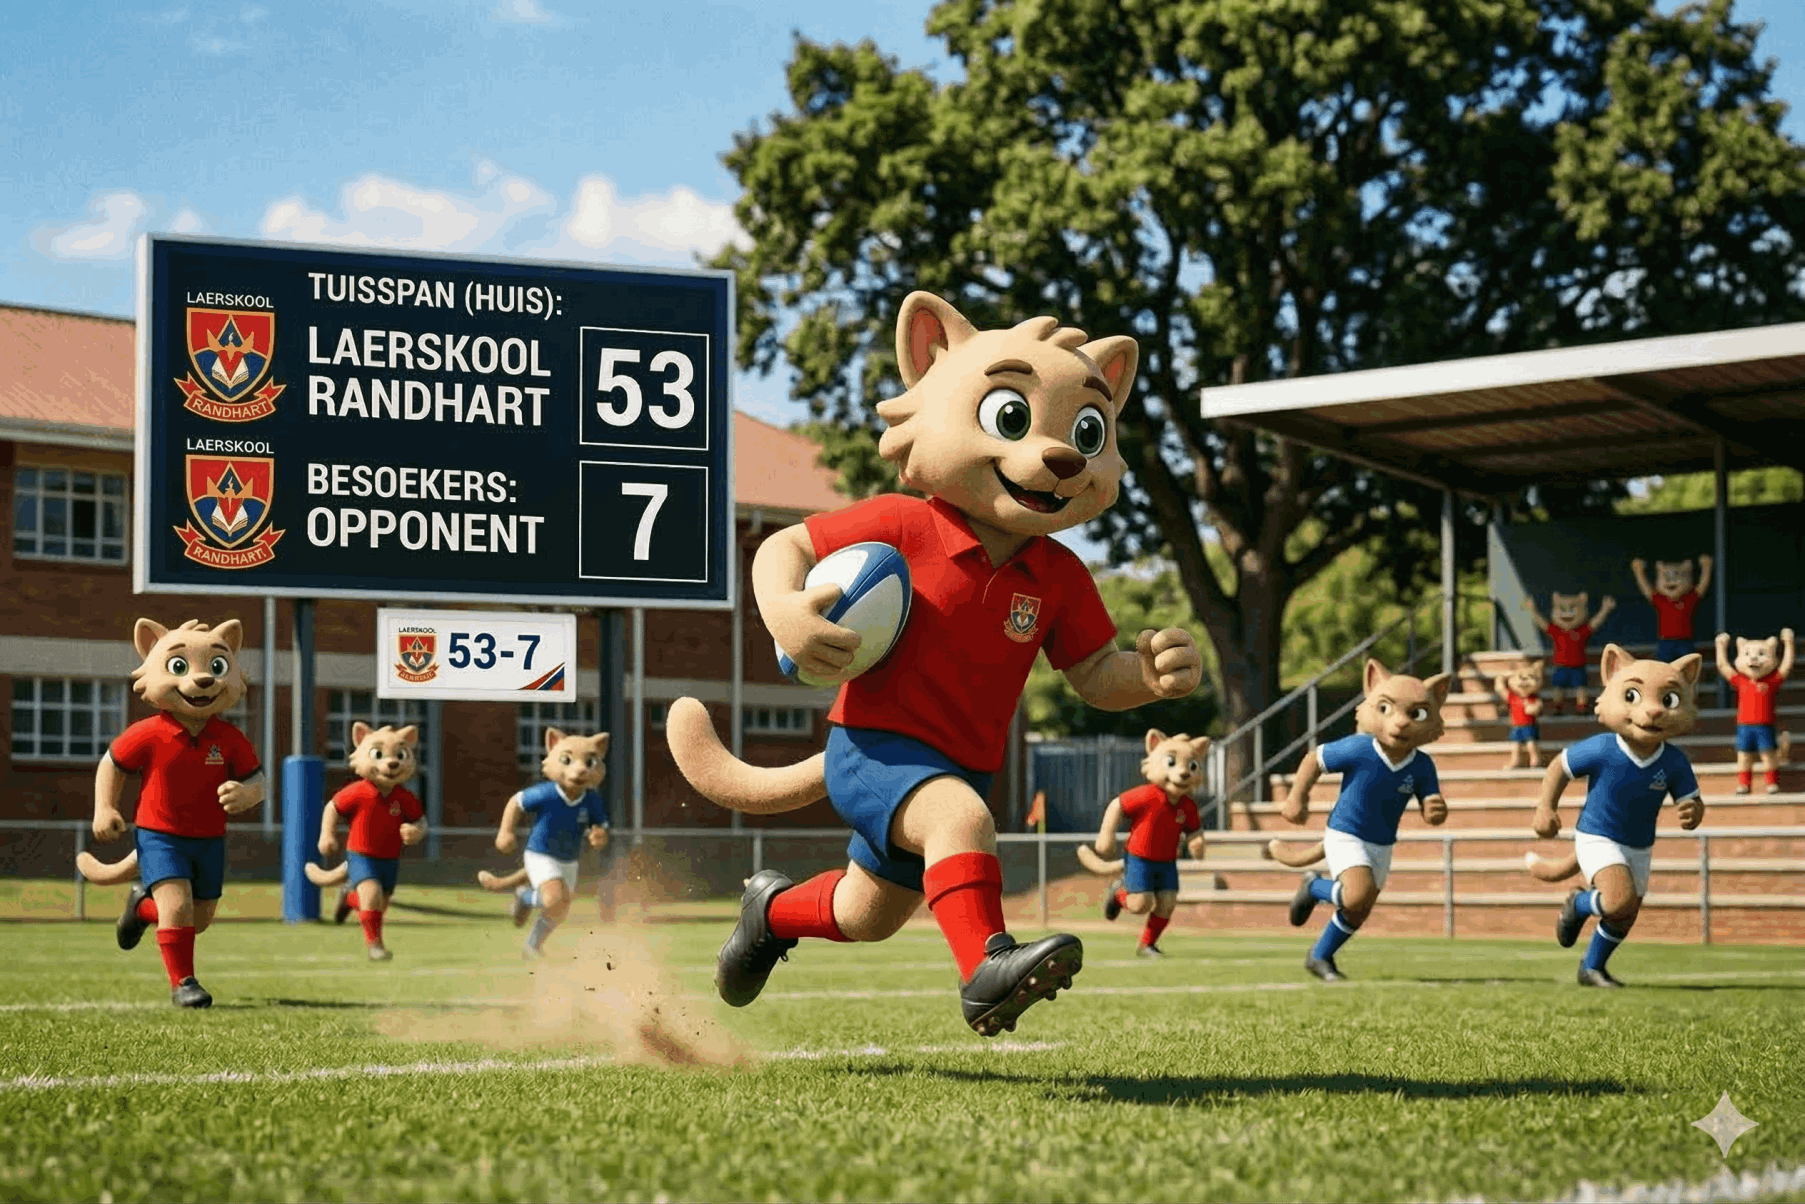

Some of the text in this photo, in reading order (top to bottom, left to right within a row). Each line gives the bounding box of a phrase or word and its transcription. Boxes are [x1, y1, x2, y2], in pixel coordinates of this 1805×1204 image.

[186, 291, 274, 308] LAERSKOOL
[308, 272, 562, 321] TUISSPAN (HUIS):
[308, 326, 552, 377] LAERSKOOL
[192, 398, 268, 418] RANDHART
[308, 374, 550, 426] RANDHART
[596, 347, 695, 429] 53
[186, 438, 275, 454] LAERSKOOL
[307, 463, 517, 503] BESOEKERS:
[307, 506, 545, 554] OPPONENT
[621, 482, 668, 561] 7
[448, 632, 541, 671] 53-7
